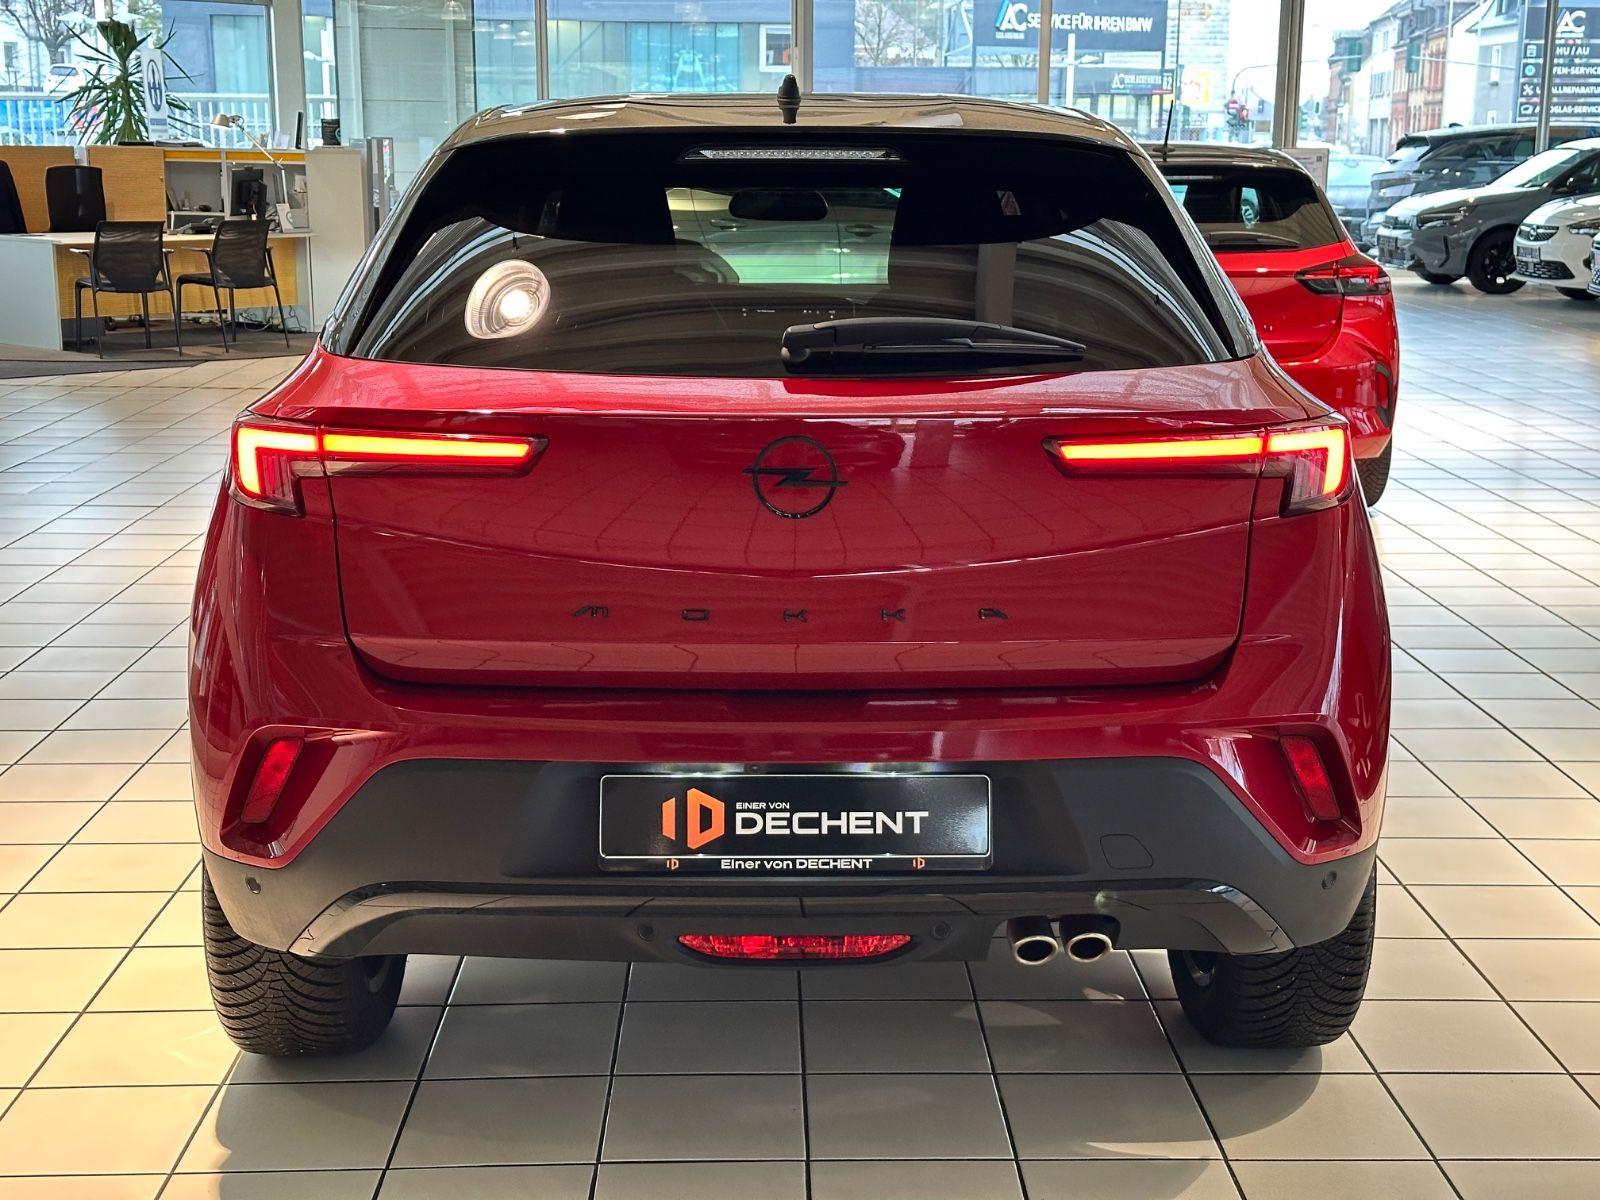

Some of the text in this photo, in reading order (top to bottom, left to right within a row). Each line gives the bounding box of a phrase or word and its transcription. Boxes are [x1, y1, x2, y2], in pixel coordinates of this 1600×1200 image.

[1027, 12, 1153, 33] SEVICE FÜR IHREN BMW
[1556, 9, 1587, 33] AC
[1556, 47, 1570, 56] HU
[1576, 47, 1590, 56] AU
[1552, 66, 1600, 75] FEN-SERVICE
[572, 605, 1008, 622] MOKKA
[735, 802, 790, 810] EINER VON
[735, 811, 929, 835] DECHENT
[720, 858, 873, 870] Einer von DECHENT
